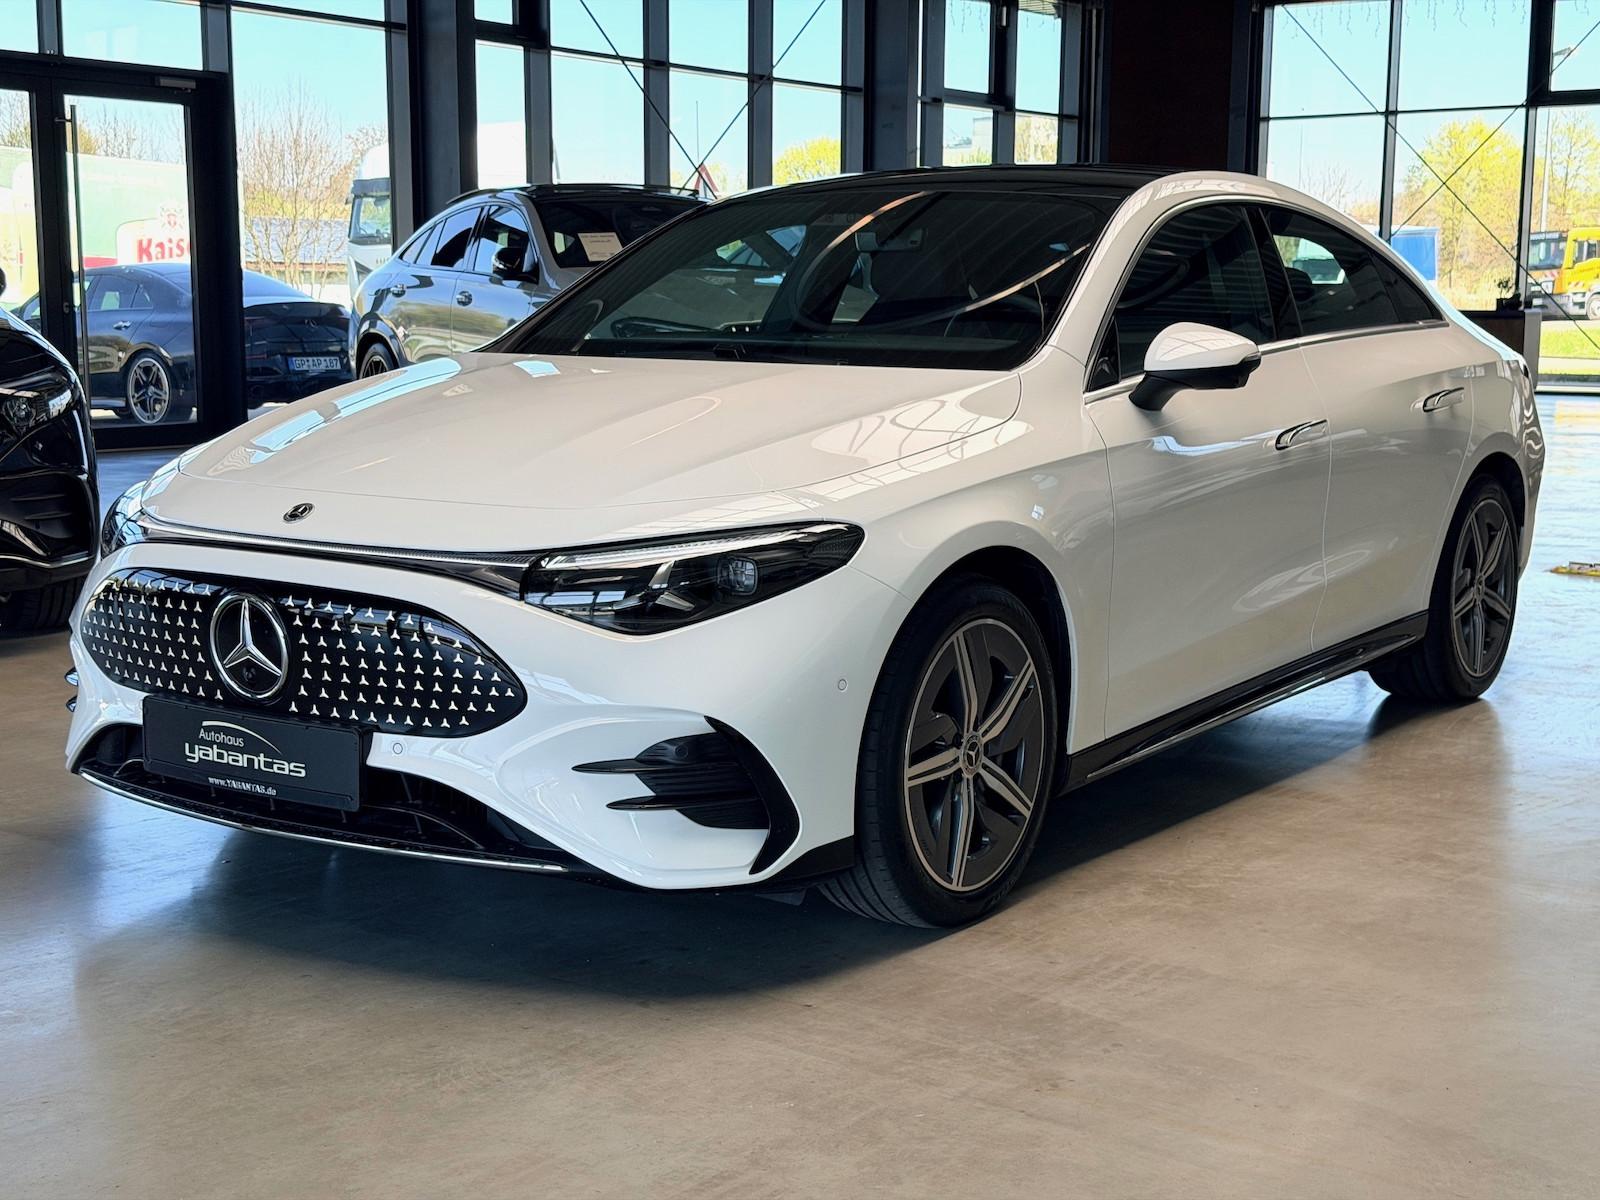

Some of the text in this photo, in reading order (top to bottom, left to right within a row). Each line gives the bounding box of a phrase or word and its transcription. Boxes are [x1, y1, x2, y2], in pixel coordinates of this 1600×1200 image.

[198, 728, 244, 747] Autohaus
[184, 742, 306, 778] yabantas
[208, 776, 277, 796] www.YABANTAS.de
